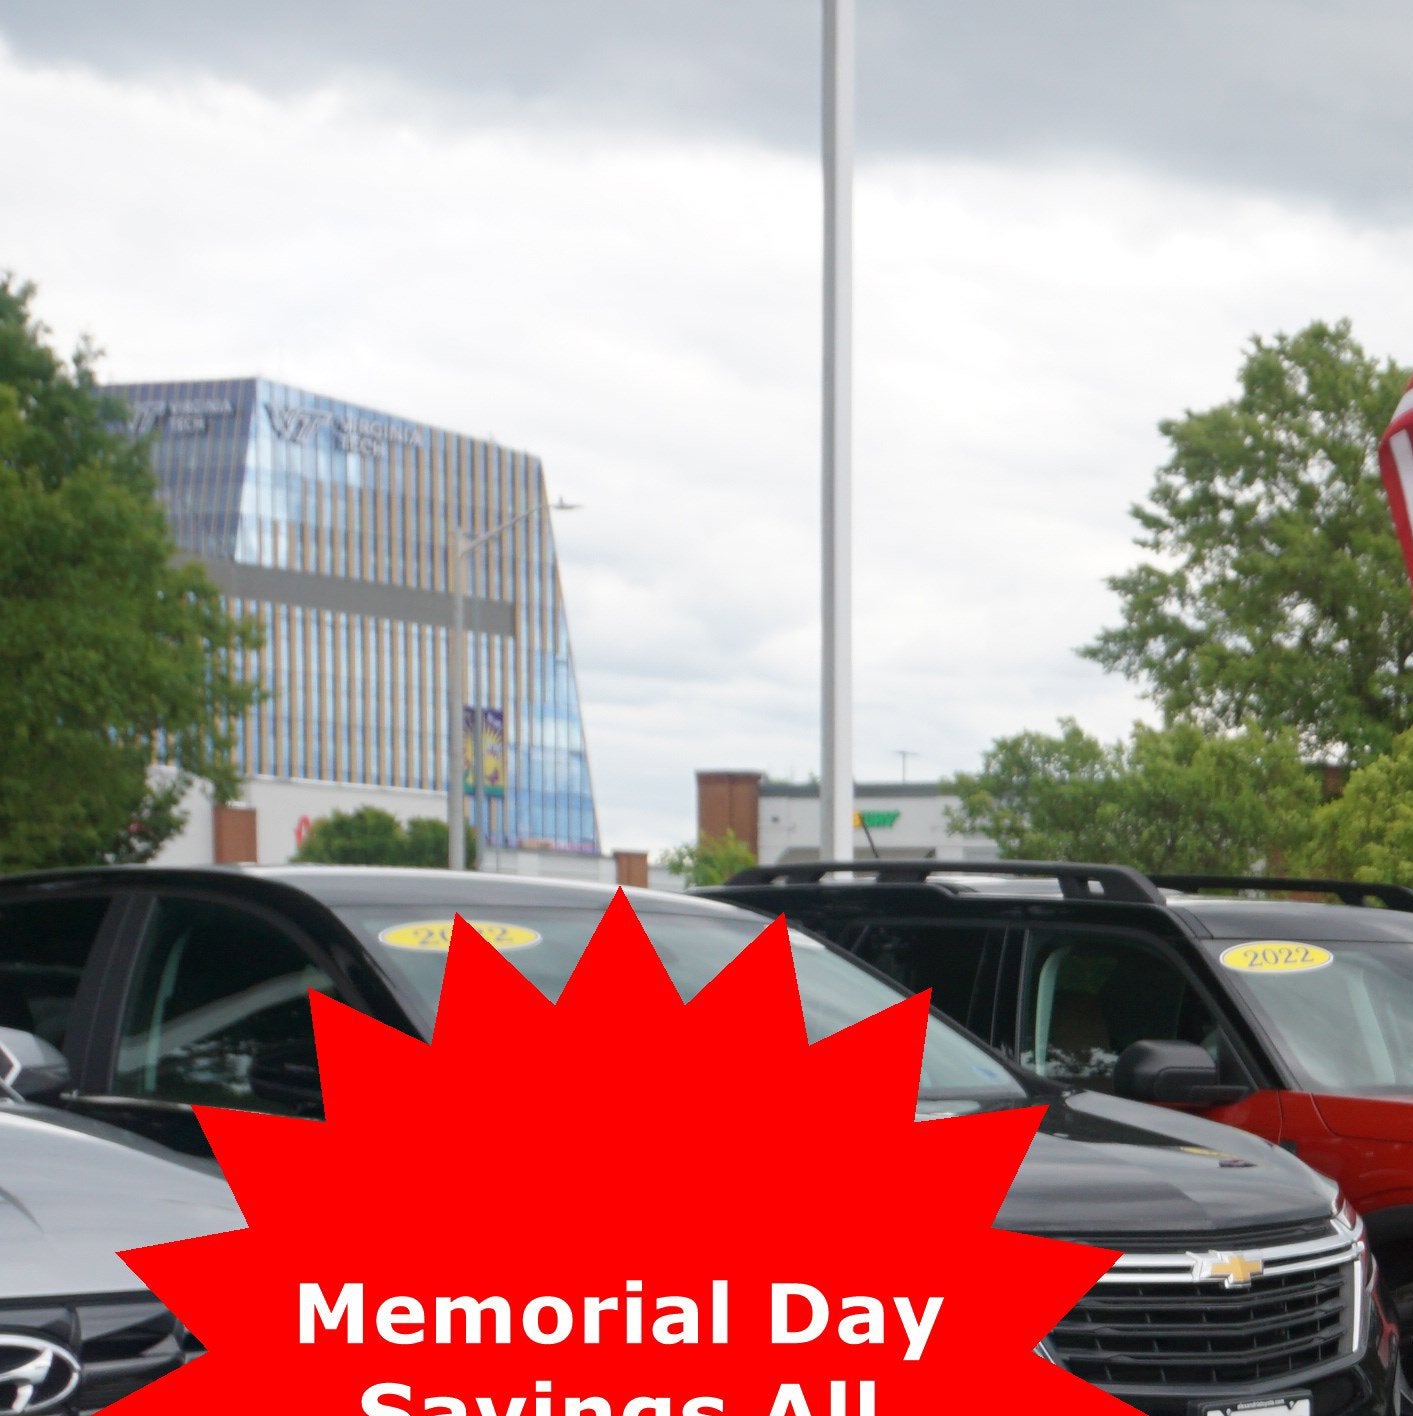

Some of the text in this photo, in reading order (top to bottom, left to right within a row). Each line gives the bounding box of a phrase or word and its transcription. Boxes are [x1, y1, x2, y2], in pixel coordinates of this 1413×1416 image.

[341, 416, 425, 447] VIRGINIA
[412, 927, 514, 945] 22
[1243, 946, 1314, 967] 2022
